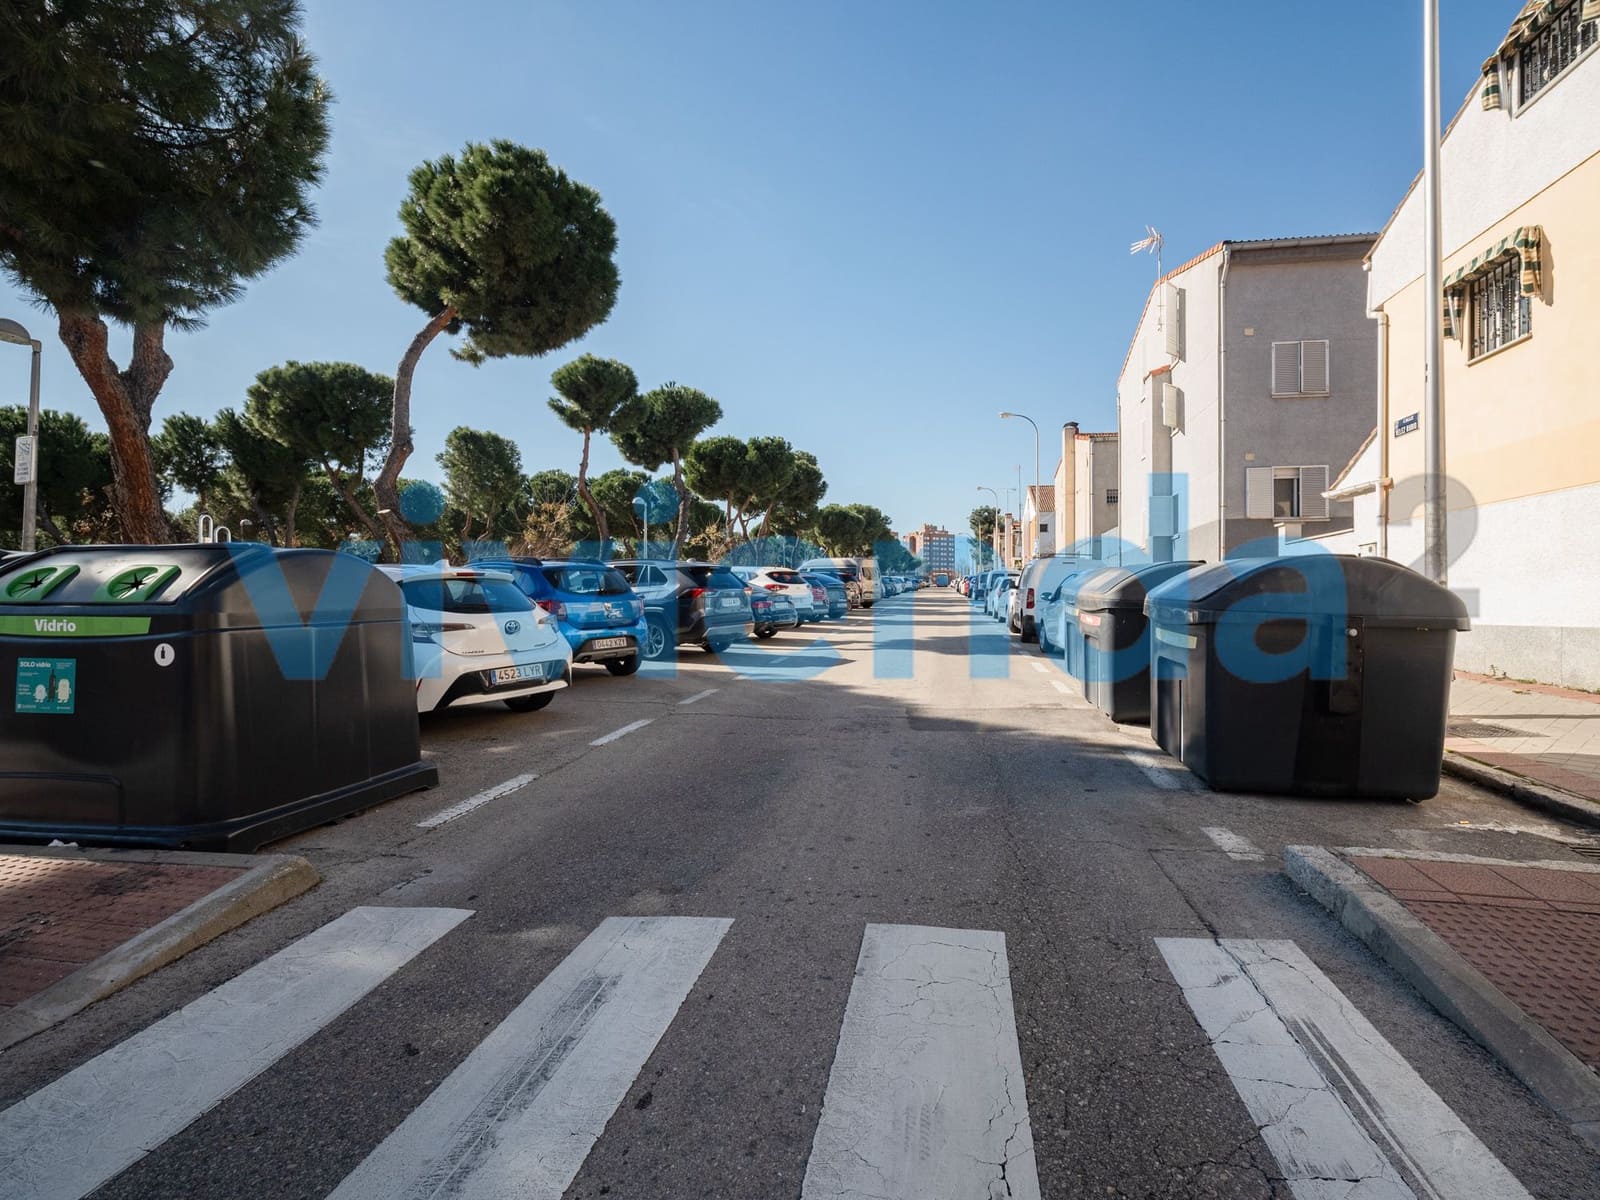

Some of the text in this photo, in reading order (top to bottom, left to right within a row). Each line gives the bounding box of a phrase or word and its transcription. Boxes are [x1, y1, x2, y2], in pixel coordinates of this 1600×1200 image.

[34, 618, 77, 632] Vidrio
[498, 664, 541, 680] 4523 LYR
